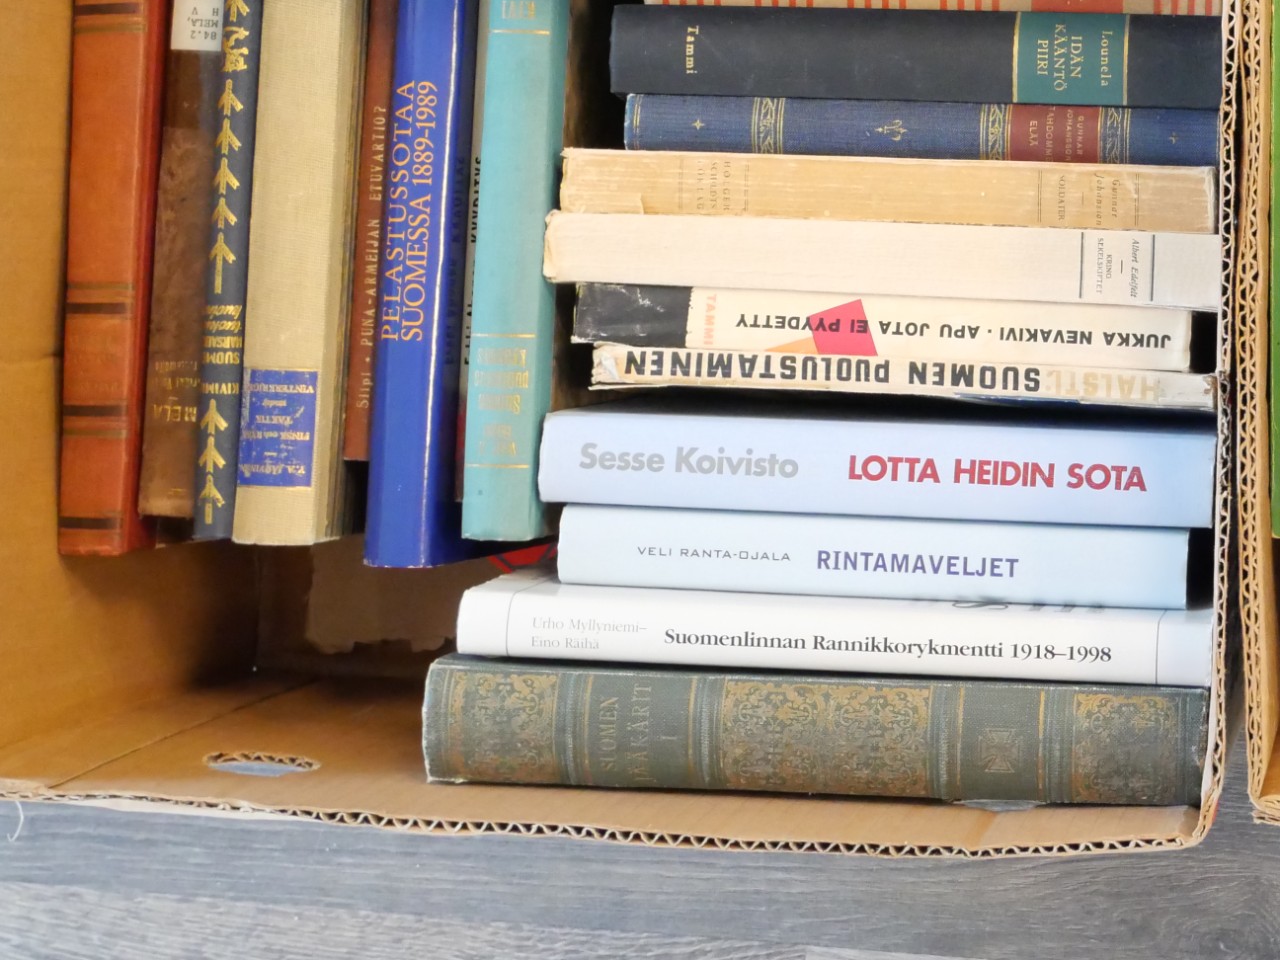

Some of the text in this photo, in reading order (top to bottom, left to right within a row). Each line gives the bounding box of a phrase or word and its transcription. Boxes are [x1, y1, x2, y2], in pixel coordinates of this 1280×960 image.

[186, 17, 219, 29] MELA,
[191, 6, 220, 17] H V
[189, 29, 218, 41] 84.2
[685, 25, 700, 74] Tammi
[1036, 38, 1050, 77] PIIRI
[1052, 23, 1069, 91] KÄÄNTÖ
[1070, 35, 1085, 80] IDÄN
[1100, 30, 1114, 87] Lounela
[369, 104, 388, 201] ETUVARTIO?
[379, 79, 415, 341] PELASTUSSOTAA
[399, 80, 439, 342] SUOMESSA 1889-1989
[1057, 175, 1067, 222] SOLDATER
[360, 219, 381, 347] PUNA-ARMEIJAN
[1105, 254, 1113, 280] KRING
[1128, 238, 1141, 299] Albert Edelfelt
[703, 293, 718, 346] TAMMI
[735, 312, 1172, 350] JUKKA NEVAKIVI APU JOTA EI PYYDETTY
[623, 350, 891, 384] PUOLUSTAMINEN
[908, 360, 1041, 393] SUOMEN
[578, 442, 1148, 492] Sesse Koivisto LOTTA HEIDIN SOTA
[637, 546, 1020, 579] VELI RANTA-OJALA RINTAMAVELJET
[531, 616, 565, 631] Urho
[664, 627, 807, 651] Suomenlinnan
[812, 634, 1004, 659] Rannikkorykmentti
